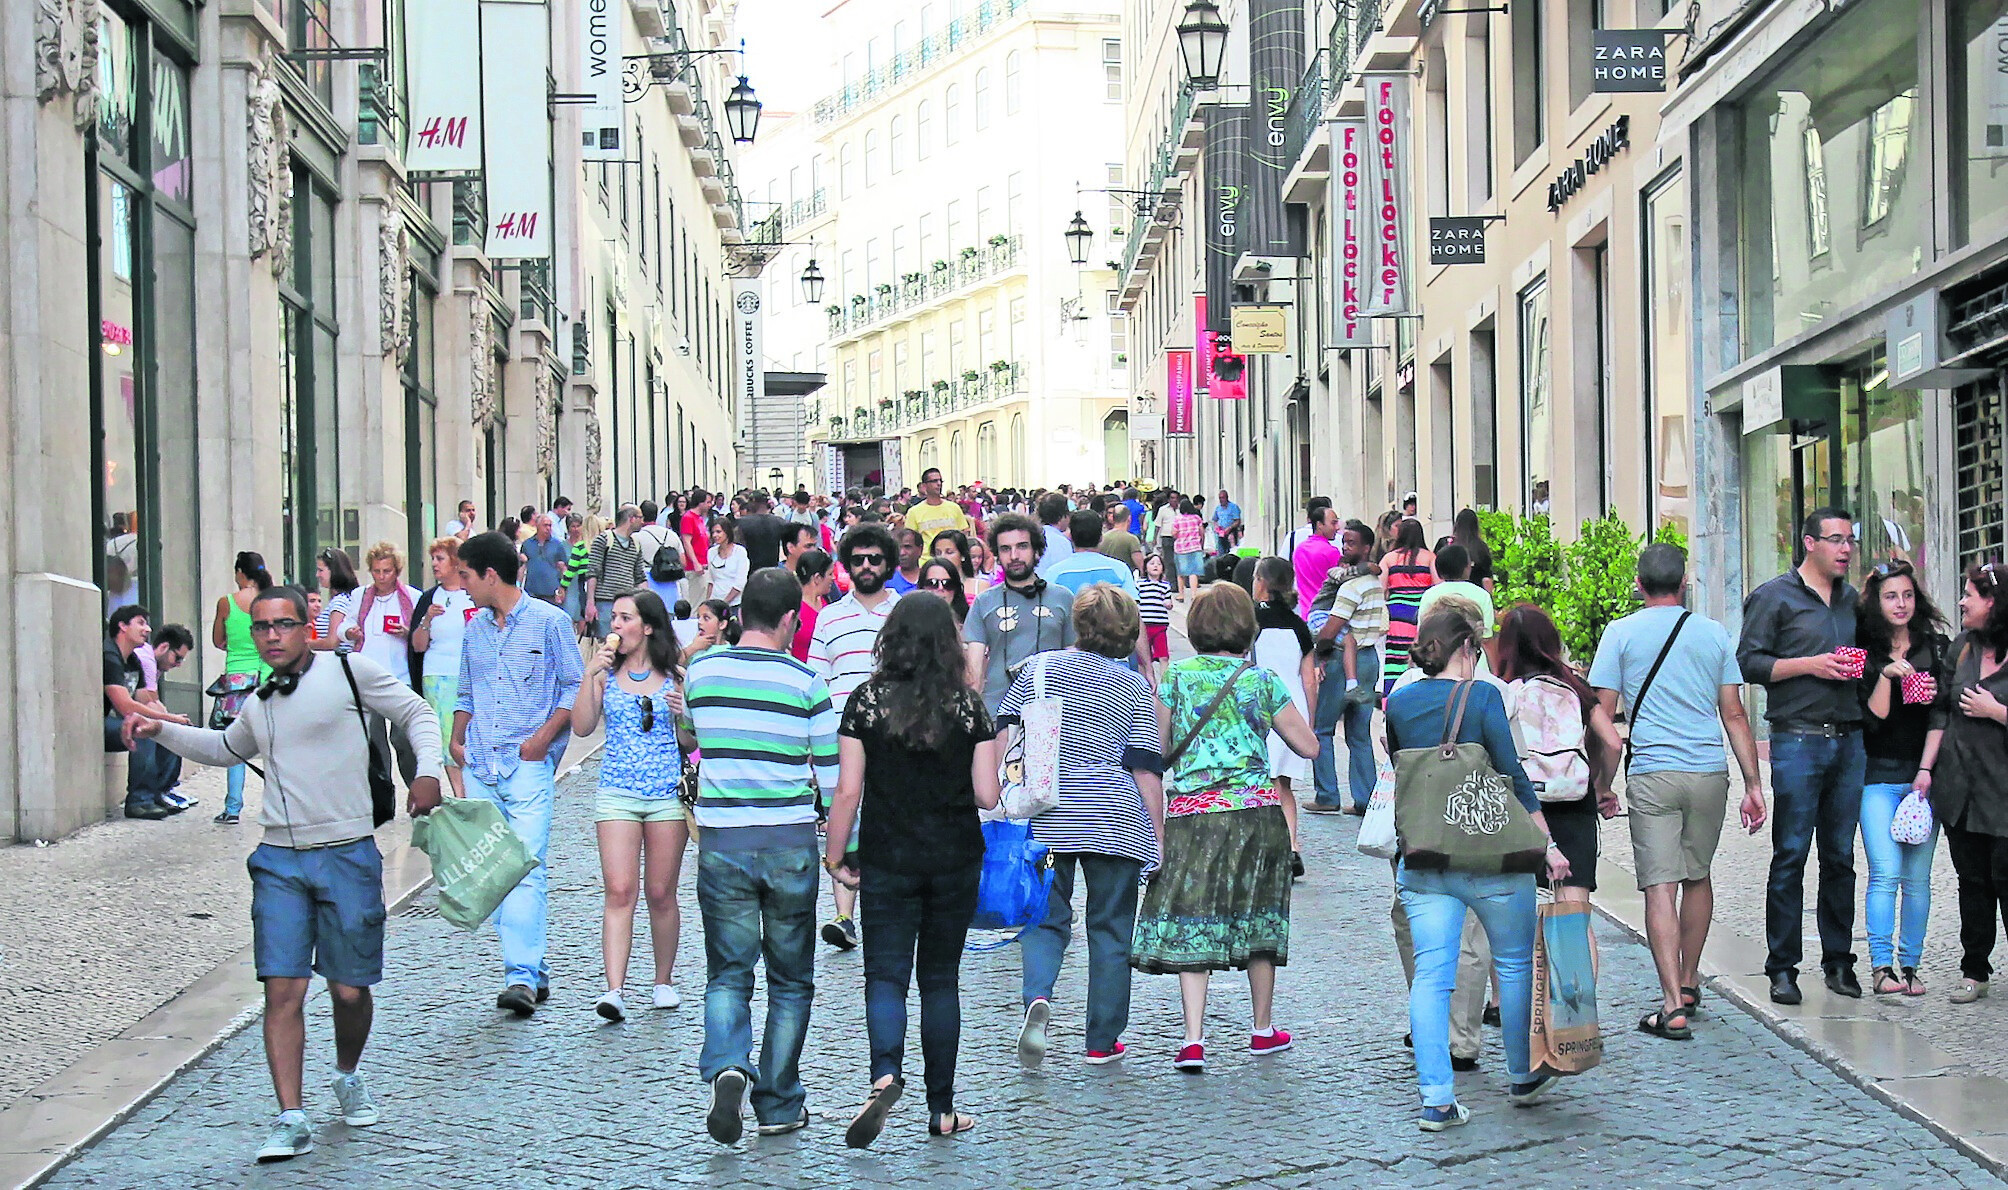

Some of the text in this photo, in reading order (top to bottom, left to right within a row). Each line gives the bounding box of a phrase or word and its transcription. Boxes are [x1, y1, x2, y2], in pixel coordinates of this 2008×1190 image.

[1595, 46, 1664, 60] ZARA
[1594, 66, 1664, 80] HOME
[417, 116, 468, 150] H&M
[1267, 87, 1290, 147] envy
[1547, 114, 1630, 213] ZARA HOME
[1219, 186, 1241, 237] envy
[1378, 82, 1399, 306] Foot Locker
[495, 211, 538, 240] H&M
[1342, 127, 1359, 340] Foot Locker
[1432, 229, 1484, 240] ZARA
[1431, 244, 1484, 255] HOME
[745, 320, 753, 355] COFFEE
[1533, 942, 1545, 1035] SPRINGFIELD
